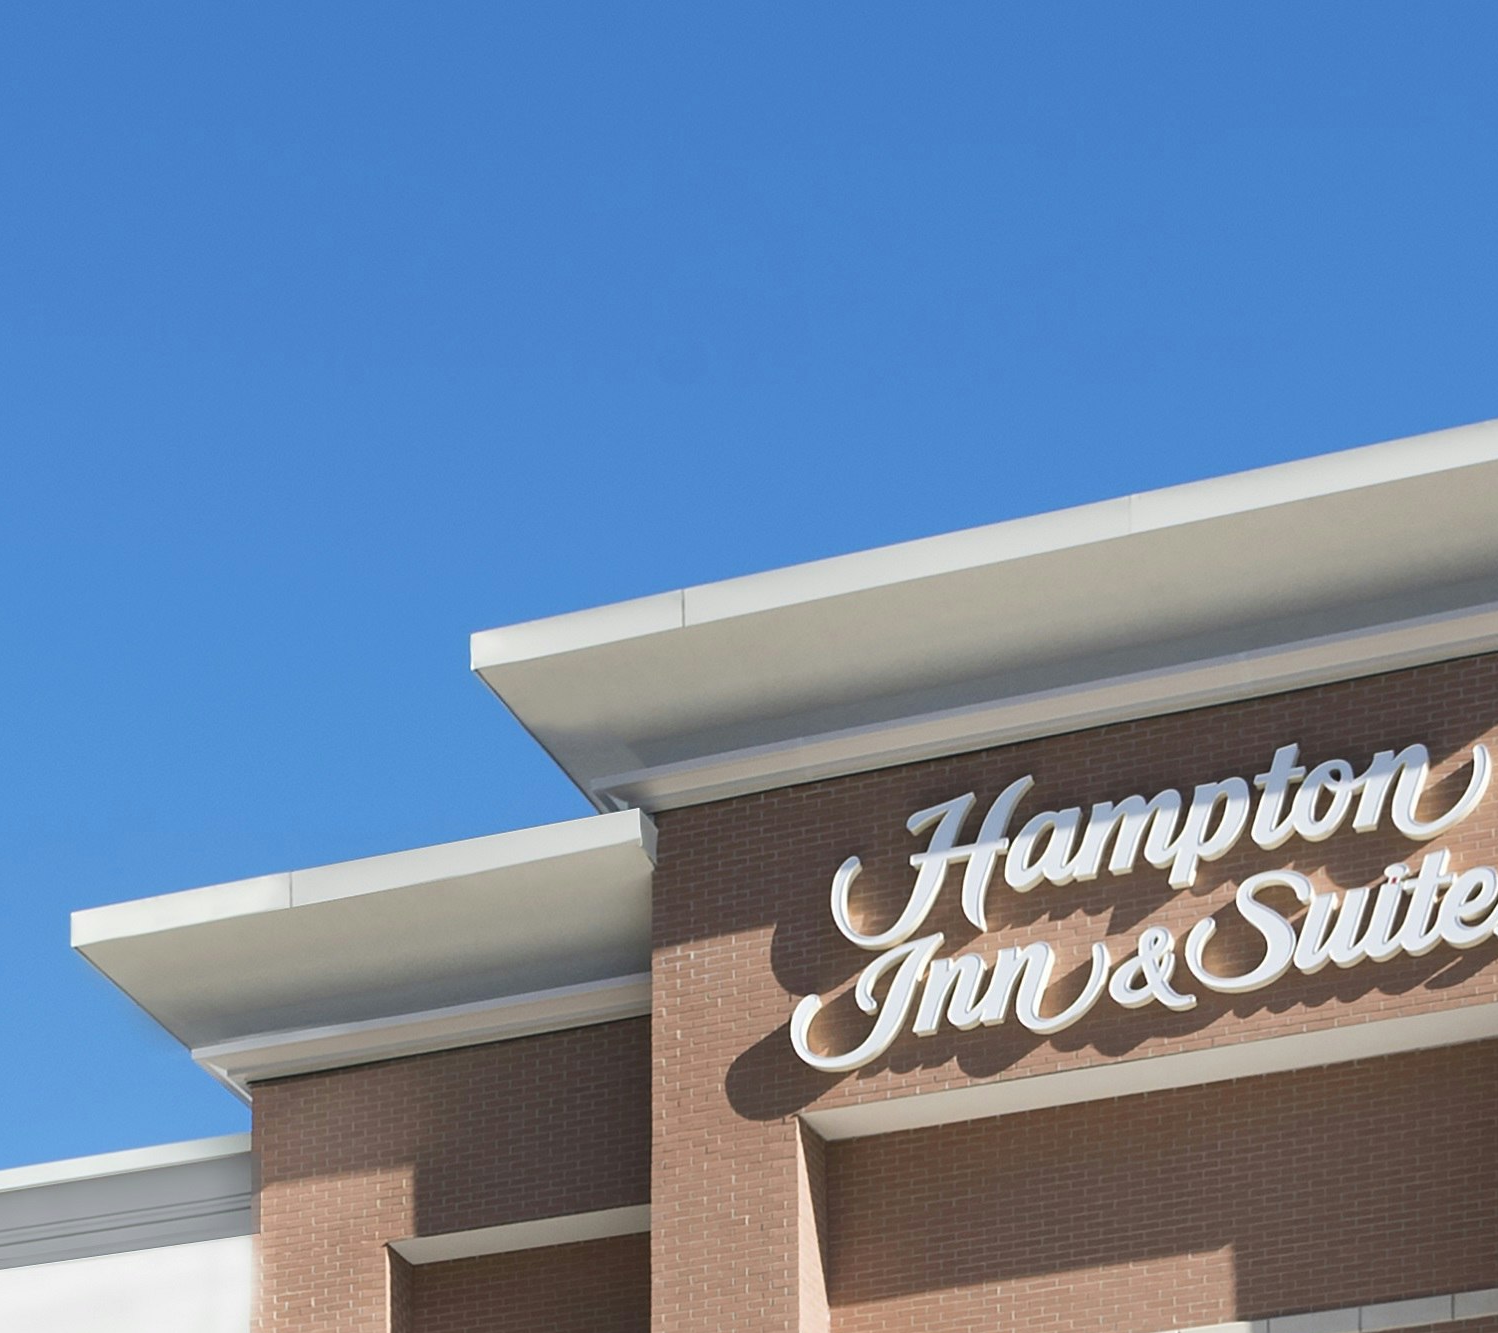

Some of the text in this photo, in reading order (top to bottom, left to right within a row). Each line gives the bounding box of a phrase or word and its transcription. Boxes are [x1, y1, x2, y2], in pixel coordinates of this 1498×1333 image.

[830, 743, 1492, 949] Hampton
[790, 931, 1111, 1072] Inn
[1108, 926, 1197, 1011] &
